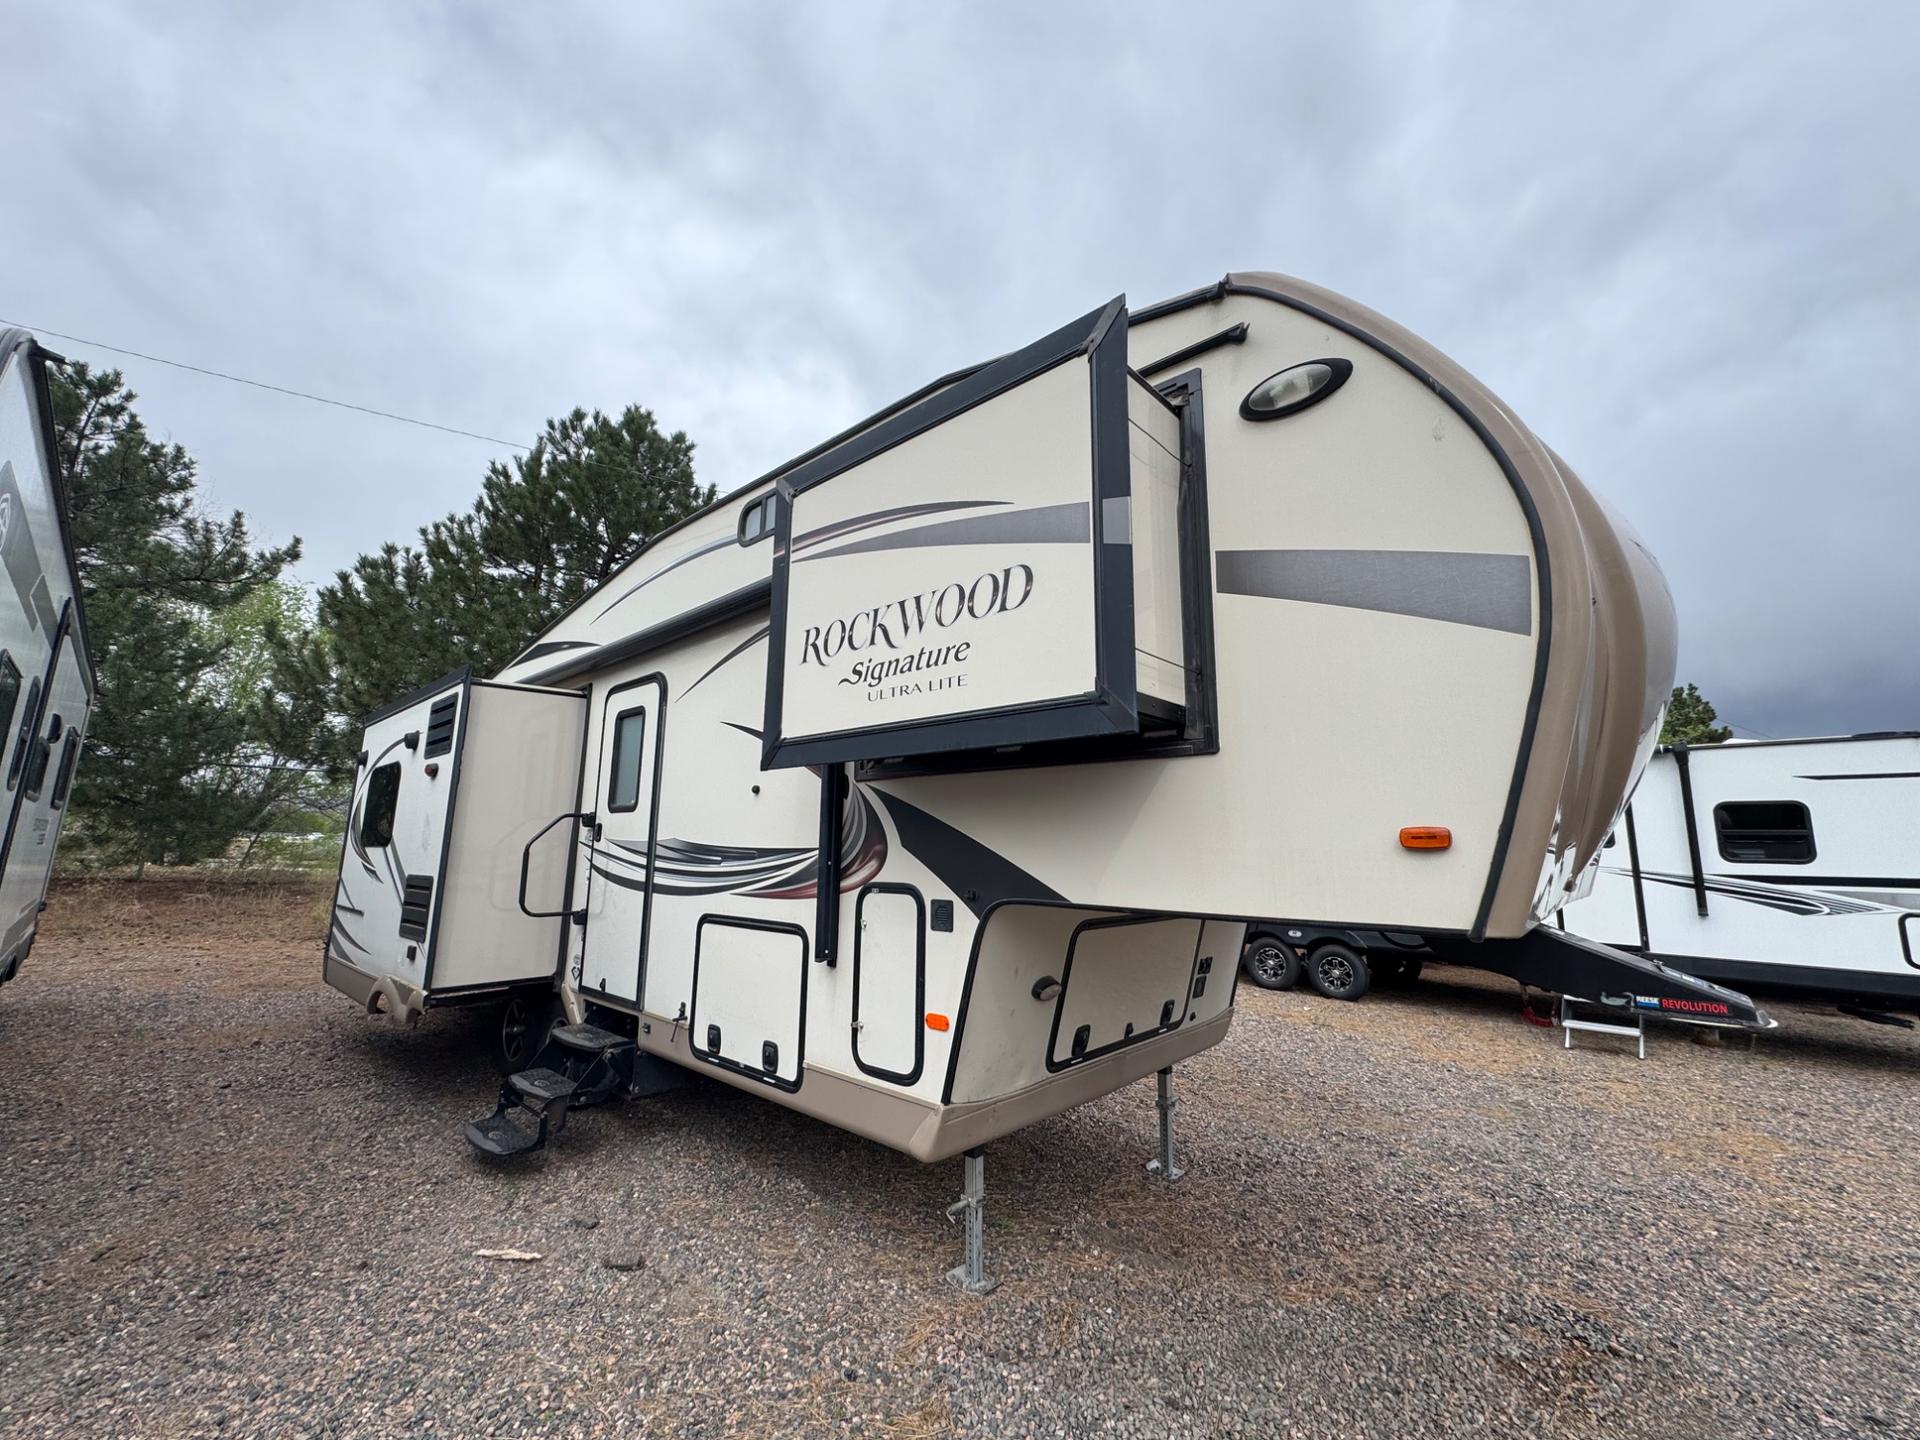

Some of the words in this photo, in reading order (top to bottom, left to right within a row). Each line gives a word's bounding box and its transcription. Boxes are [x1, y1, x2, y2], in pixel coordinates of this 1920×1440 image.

[800, 564, 1034, 667] ROCKWOOD
[838, 641, 971, 688] Signature
[868, 683, 922, 702] ULTRA
[929, 674, 968, 692] LITE
[1662, 998, 1728, 1014] REVOLUTION
